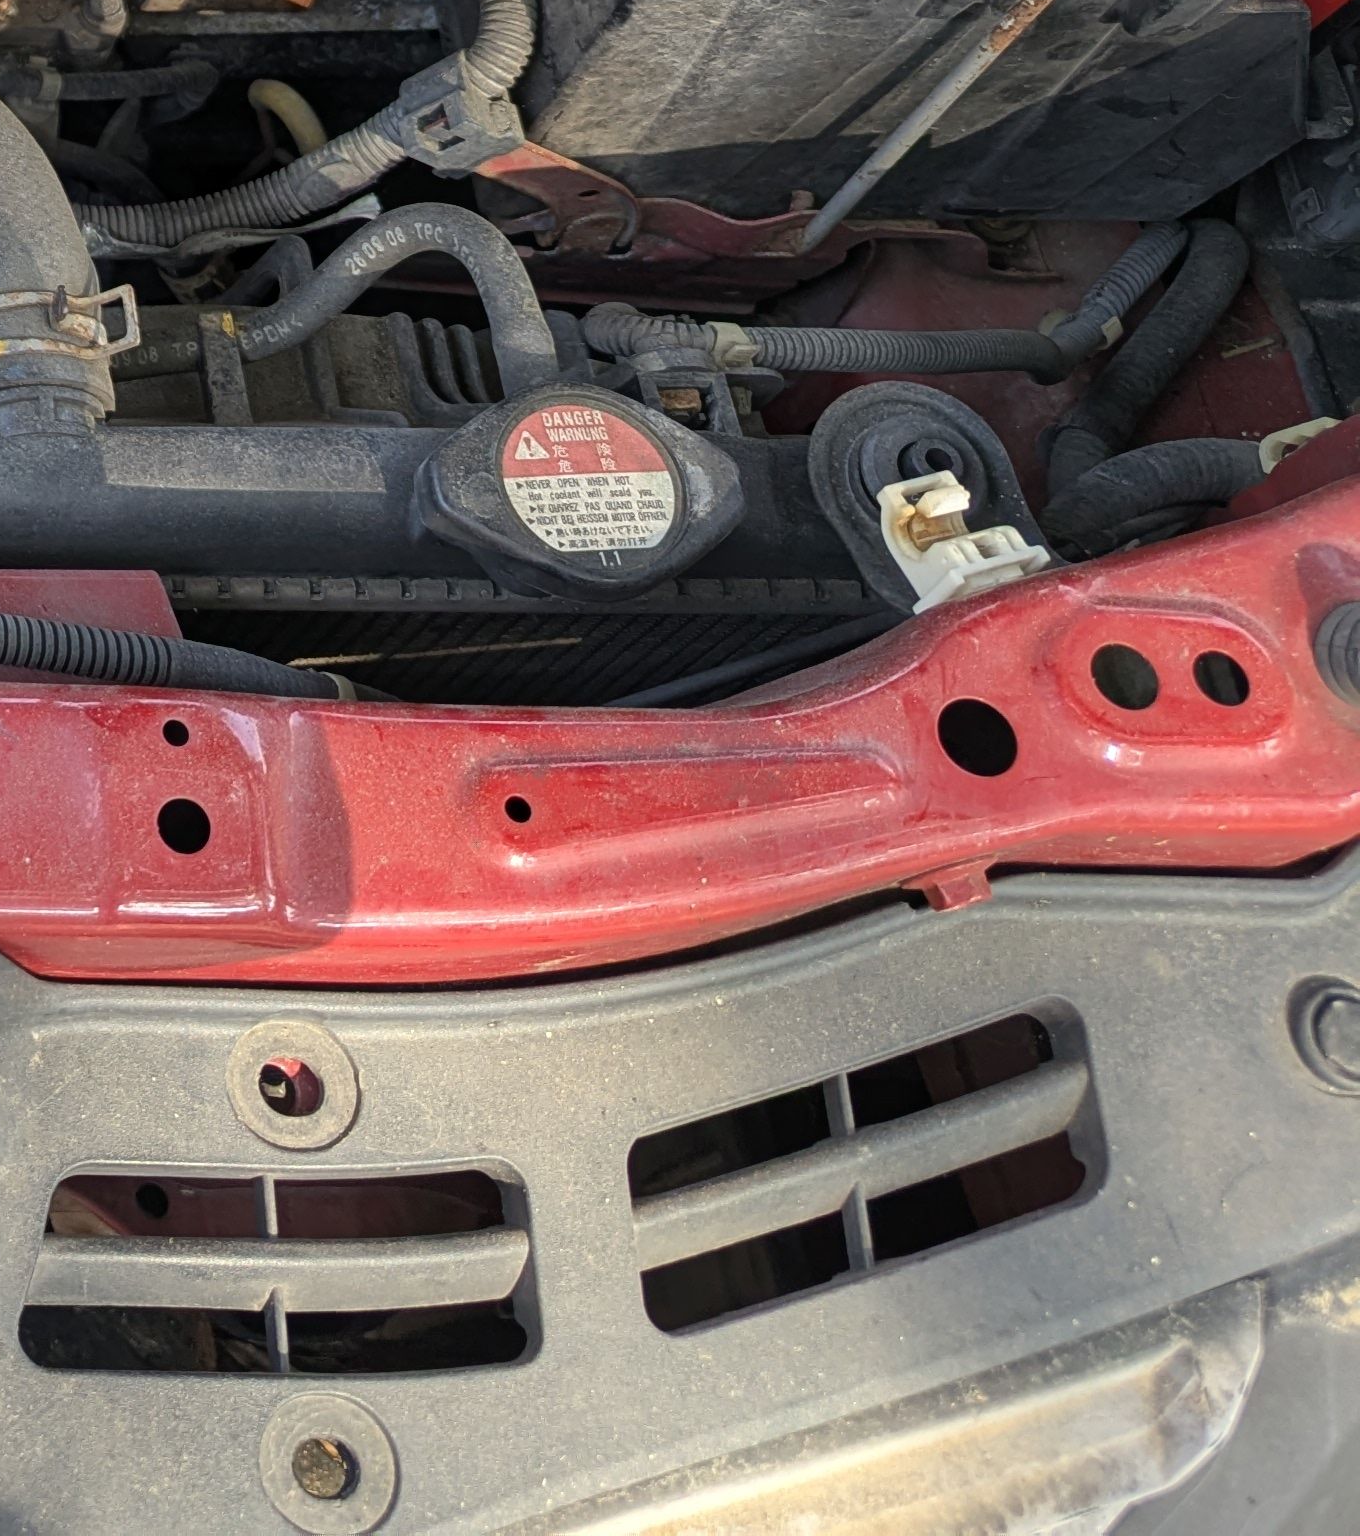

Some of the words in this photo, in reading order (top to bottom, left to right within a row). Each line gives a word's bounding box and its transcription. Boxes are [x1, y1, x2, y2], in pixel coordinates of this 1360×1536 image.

[344, 255, 367, 276] 26
[386, 226, 407, 246] 08
[414, 221, 445, 244] TPC
[541, 410, 605, 427] DANGER
[545, 426, 609, 443] WARNUNG
[526, 479, 551, 490] NEVER
[558, 478, 579, 488] OPEN
[587, 477, 609, 487] WHEN
[528, 492, 543, 501] Hot
[550, 490, 581, 500] coolant
[586, 489, 602, 498] will
[610, 488, 631, 498] scald
[548, 502, 580, 513] OUVREZ
[584, 501, 601, 511] PAS
[605, 500, 633, 511] QUAND
[536, 515, 558, 525] NICHT
[561, 515, 575, 525] BEI
[578, 513, 610, 524] HEISSEM
[612, 512, 636, 521] MOTOR
[598, 550, 622, 567] 1.1
